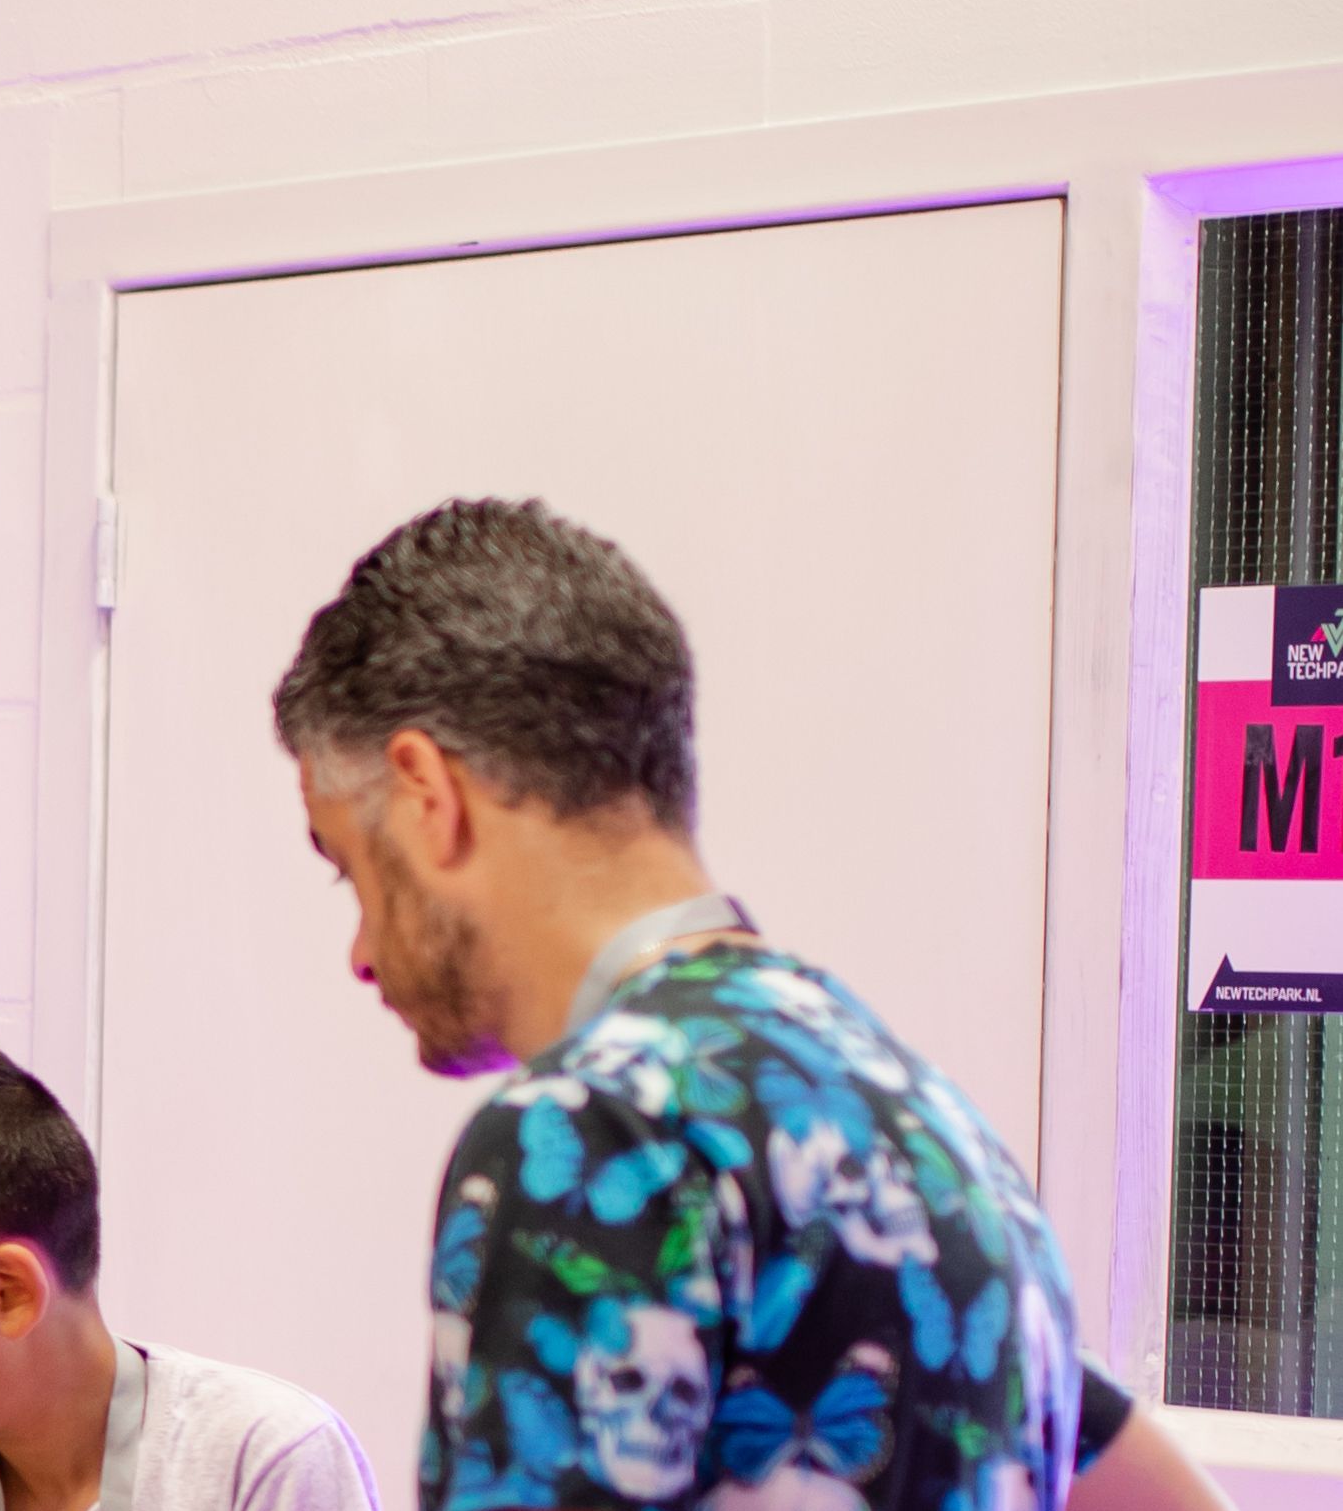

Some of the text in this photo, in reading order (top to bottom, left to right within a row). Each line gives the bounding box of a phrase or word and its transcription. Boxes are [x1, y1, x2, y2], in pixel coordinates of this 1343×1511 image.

[1287, 644, 1324, 662] NEW
[1287, 661, 1343, 680] TECHPA
[1215, 985, 1323, 1004] NEWTECHPARK.NL
